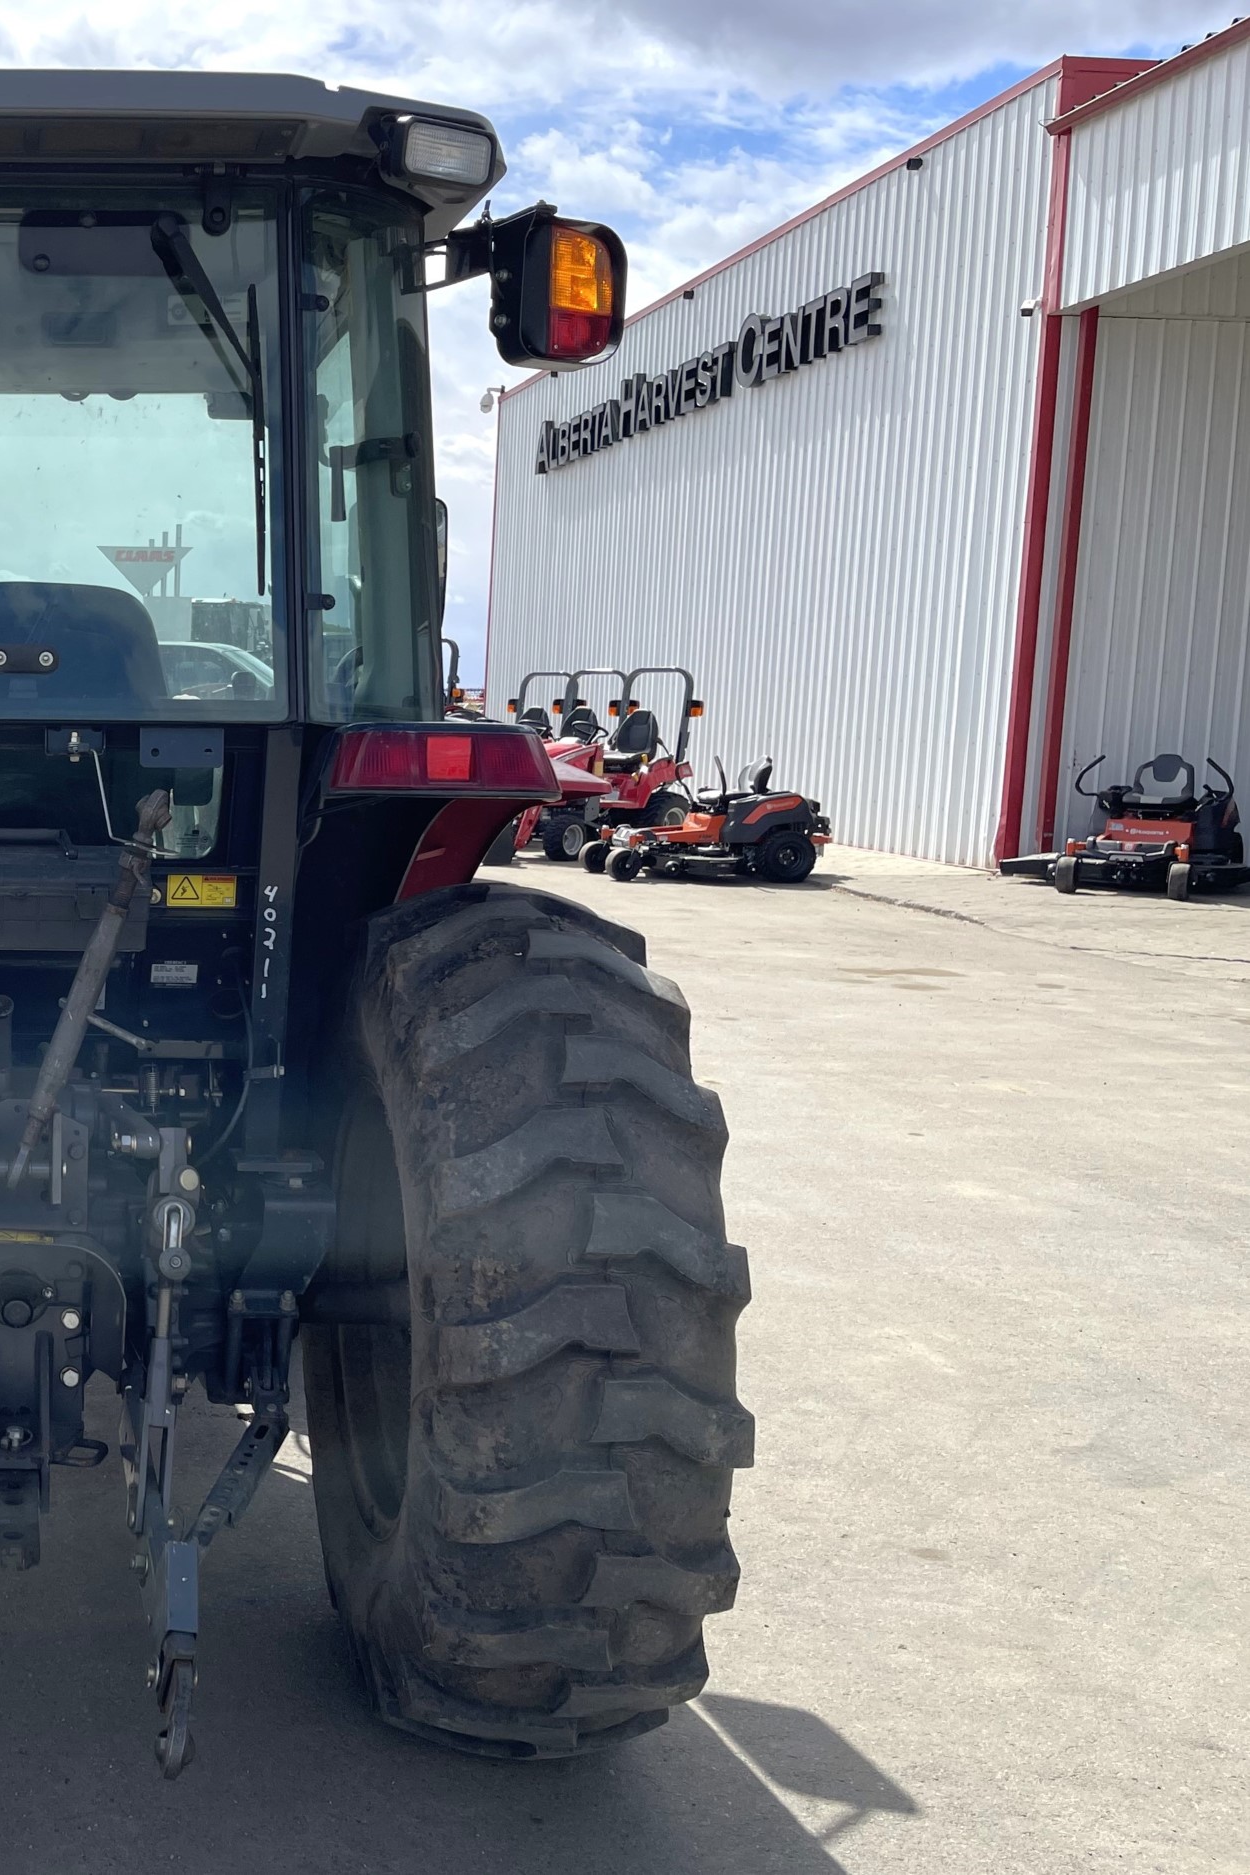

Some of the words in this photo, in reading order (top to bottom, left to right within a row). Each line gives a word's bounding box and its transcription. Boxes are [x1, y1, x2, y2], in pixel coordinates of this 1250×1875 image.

[535, 399, 619, 474] ALBERTA
[618, 341, 737, 441] HARVEST
[736, 272, 885, 389] CENTRE
[115, 550, 175, 562] CLAAS
